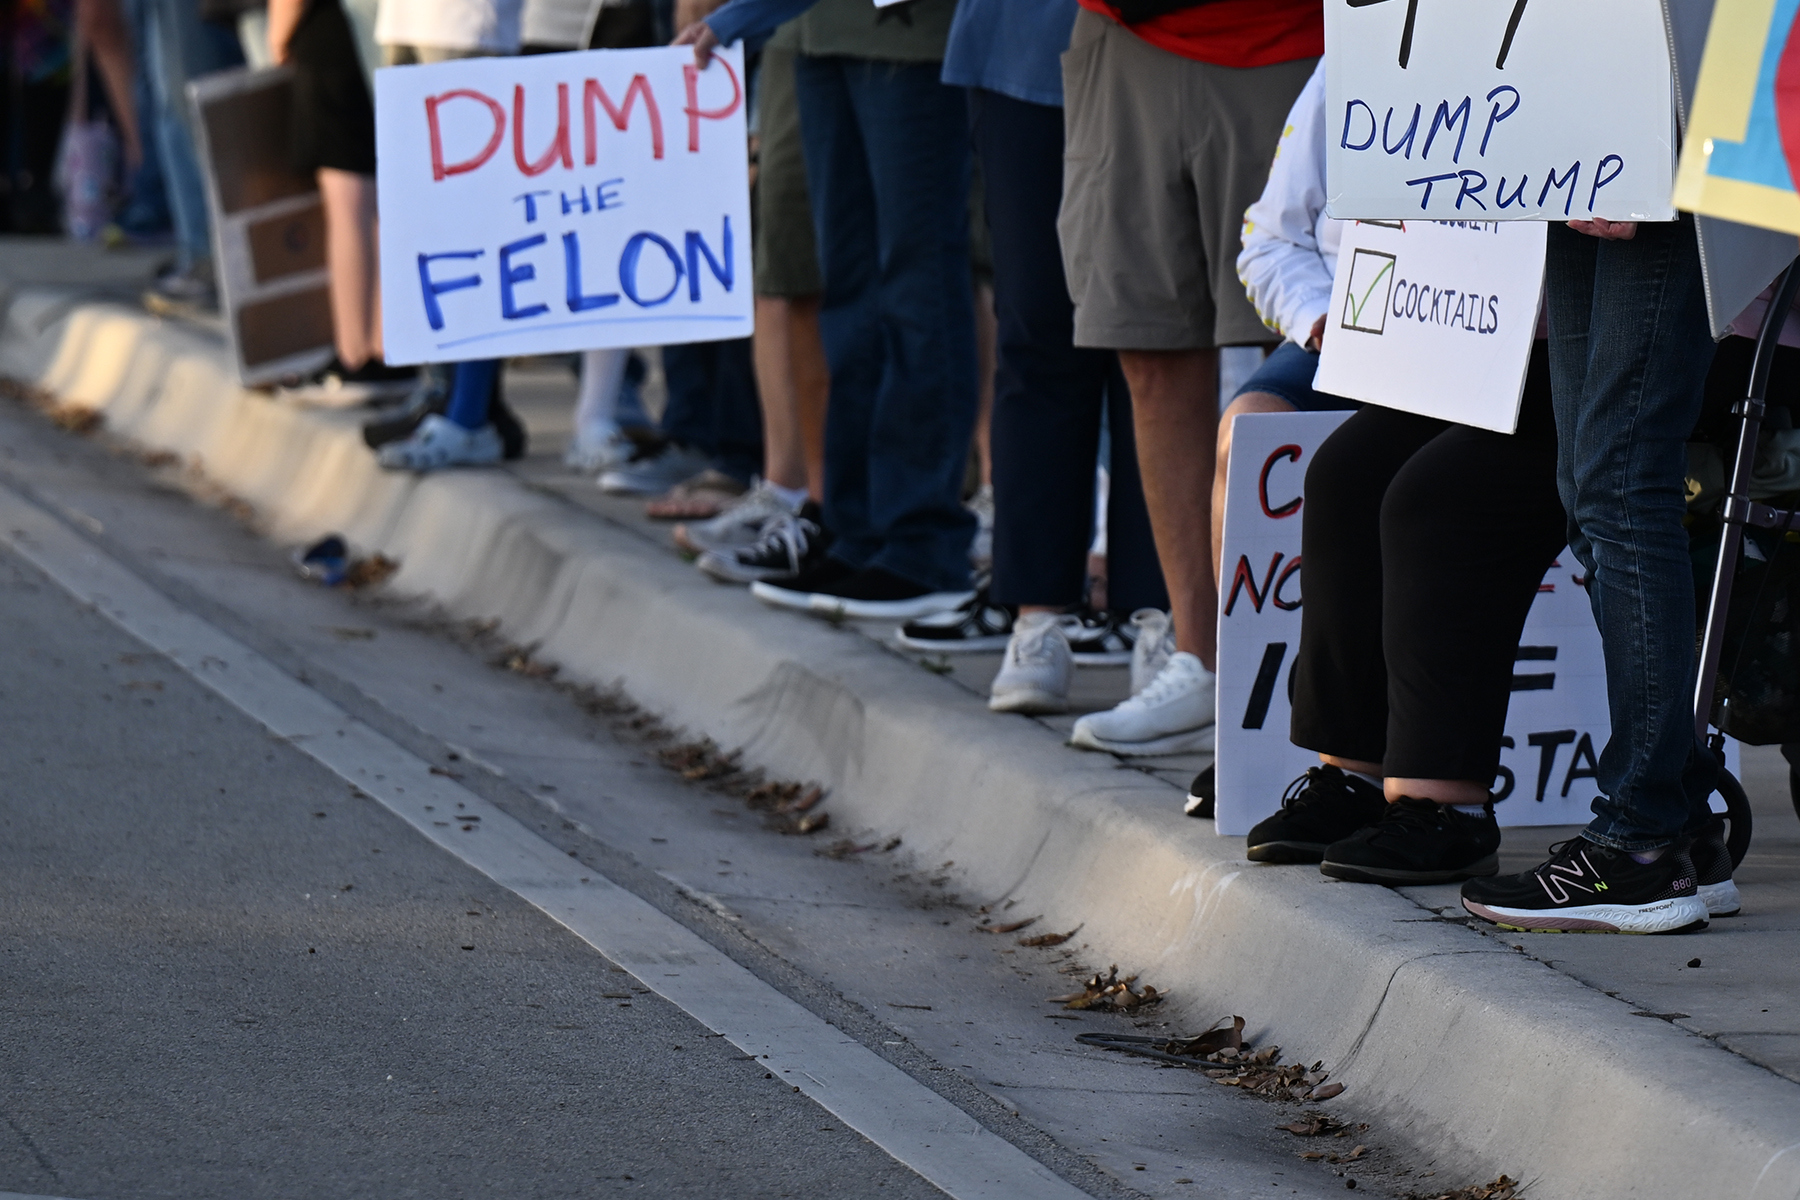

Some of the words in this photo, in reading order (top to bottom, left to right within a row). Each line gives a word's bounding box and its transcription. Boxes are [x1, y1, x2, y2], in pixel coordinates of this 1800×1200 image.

[425, 53, 743, 183] DUMP
[1341, 84, 1521, 164] DUMP
[513, 177, 626, 223] THE
[1406, 153, 1626, 216] TRUMP
[417, 214, 735, 332] FELON
[1392, 278, 1499, 335] COCKTAILS
[1672, 876, 1692, 891] 880
